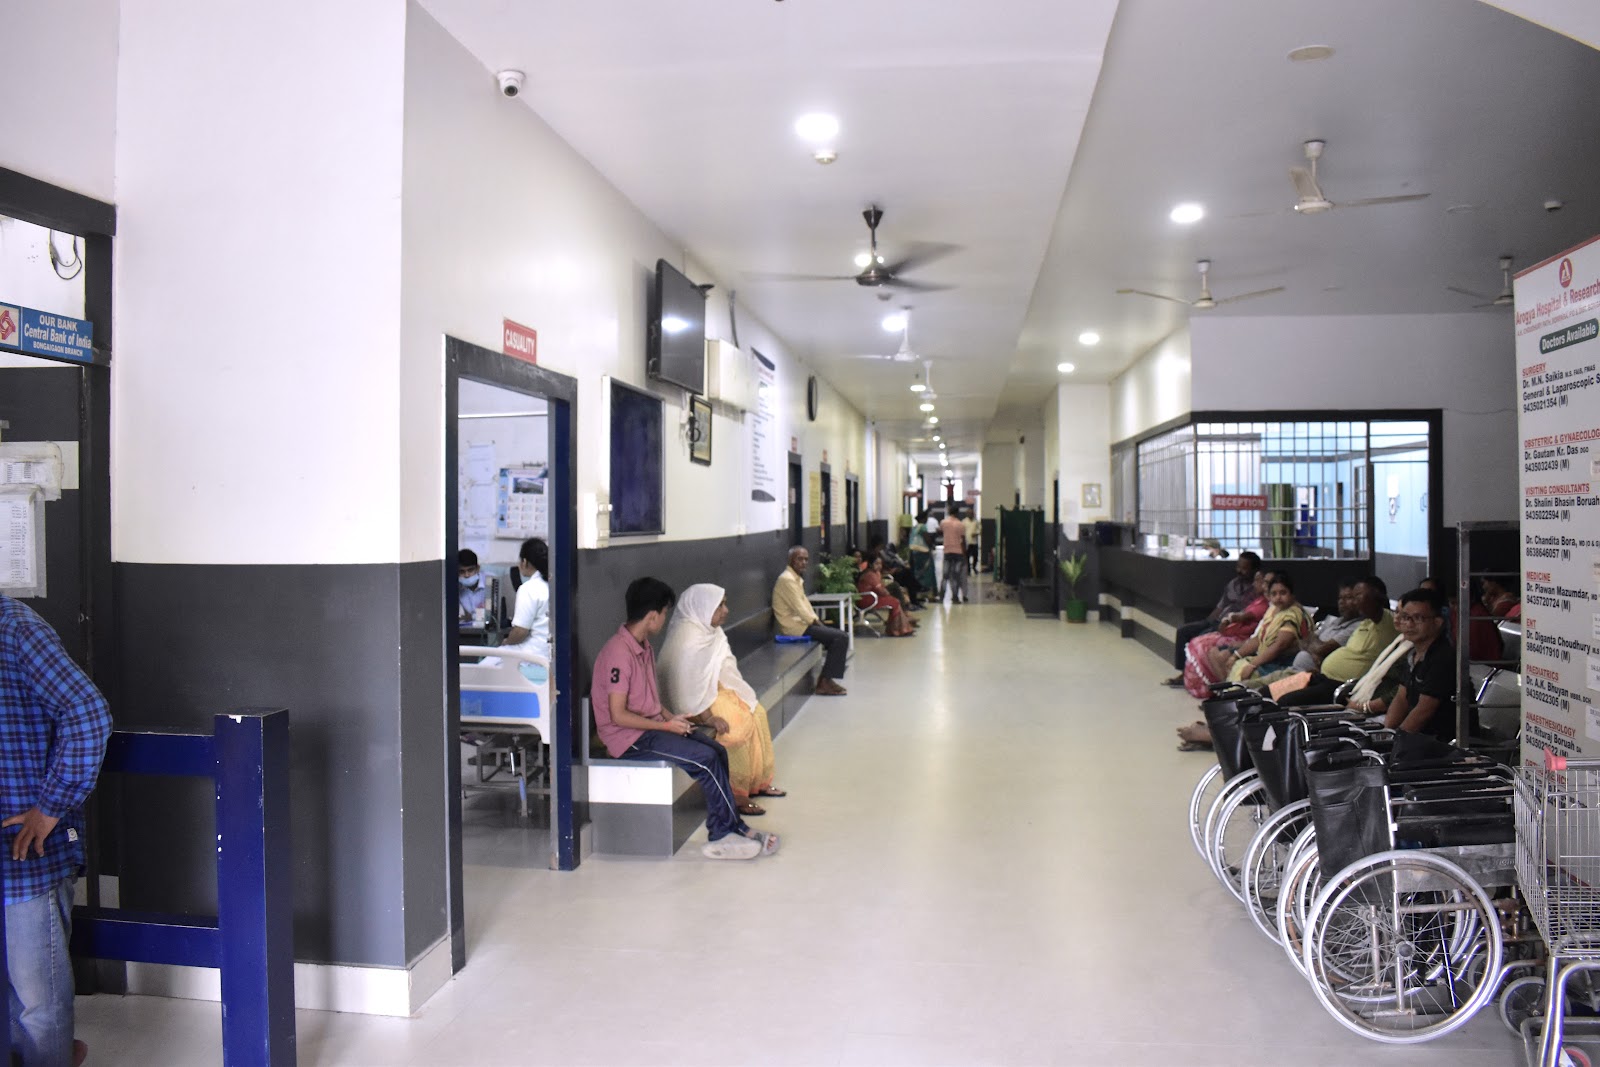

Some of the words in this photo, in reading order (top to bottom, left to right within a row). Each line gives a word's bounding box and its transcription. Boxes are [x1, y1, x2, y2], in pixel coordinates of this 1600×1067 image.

[1516, 309, 1536, 325] Arogya
[1537, 294, 1561, 317] Hospital
[1563, 292, 1568, 306] &
[40, 315, 56, 328] OUR
[58, 319, 78, 332] BANK
[24, 323, 48, 340] Central
[50, 329, 66, 345] Bank
[68, 333, 76, 346] of
[76, 334, 92, 350] India
[1542, 334, 1566, 350] Doctors
[1566, 323, 1596, 342] Available
[65, 347, 83, 356] BRANCH
[1522, 362, 1546, 376] SURGERY
[1532, 375, 1544, 386] M.N.
[1545, 370, 1564, 382] Saikia
[1523, 388, 1544, 400] General
[1546, 386, 1550, 396] &
[1552, 376, 1594, 394] Laparoscopic
[1524, 397, 1557, 413] 9435021354
[1559, 395, 1568, 408] (M)
[1524, 436, 1552, 448] OBSTETRIC
[1554, 435, 1558, 444] &
[1533, 449, 1555, 459] Gautam
[1557, 446, 1566, 456] Kr.
[1567, 445, 1578, 455] Das
[1525, 460, 1558, 472] 9435032439
[1560, 459, 1570, 471] (M)
[1525, 486, 1547, 495] VISITING
[1549, 483, 1590, 494] CONSULTANTS
[1214, 497, 1264, 507] RECEPTION
[1534, 498, 1553, 508] Shalini
[1555, 496, 1575, 507] Bhasin
[1577, 495, 1600, 506] Boruah
[1526, 510, 1559, 520] 9435022594
[1561, 510, 1570, 522] (M)
[1535, 535, 1559, 546] Chandita
[1561, 536, 1578, 548] Bora,
[1561, 549, 1570, 562] (M)
[1526, 571, 1550, 582] MEDICINE
[1556, 586, 1589, 602] Mazumdar,
[1526, 595, 1560, 608] 9435720724
[1561, 600, 1570, 612] (M)
[1526, 618, 1536, 628] ENT
[1535, 632, 1556, 645] Diganta
[1558, 636, 1590, 655] Choudhury
[1526, 642, 1560, 658] 9864017910
[1561, 650, 1570, 663] (M)
[611, 668, 620, 684] 3
[1526, 664, 1558, 680] PAEDIATRICS
[1534, 678, 1546, 690] A.K.
[1548, 682, 1568, 697] Bhuyan
[1526, 688, 1559, 707] 9435022305
[1560, 698, 1570, 712] (M)
[1526, 712, 1576, 737] ANAESTHESIOLOGY
[1534, 726, 1552, 744] Rituraj
[1554, 734, 1574, 750] Boruah
